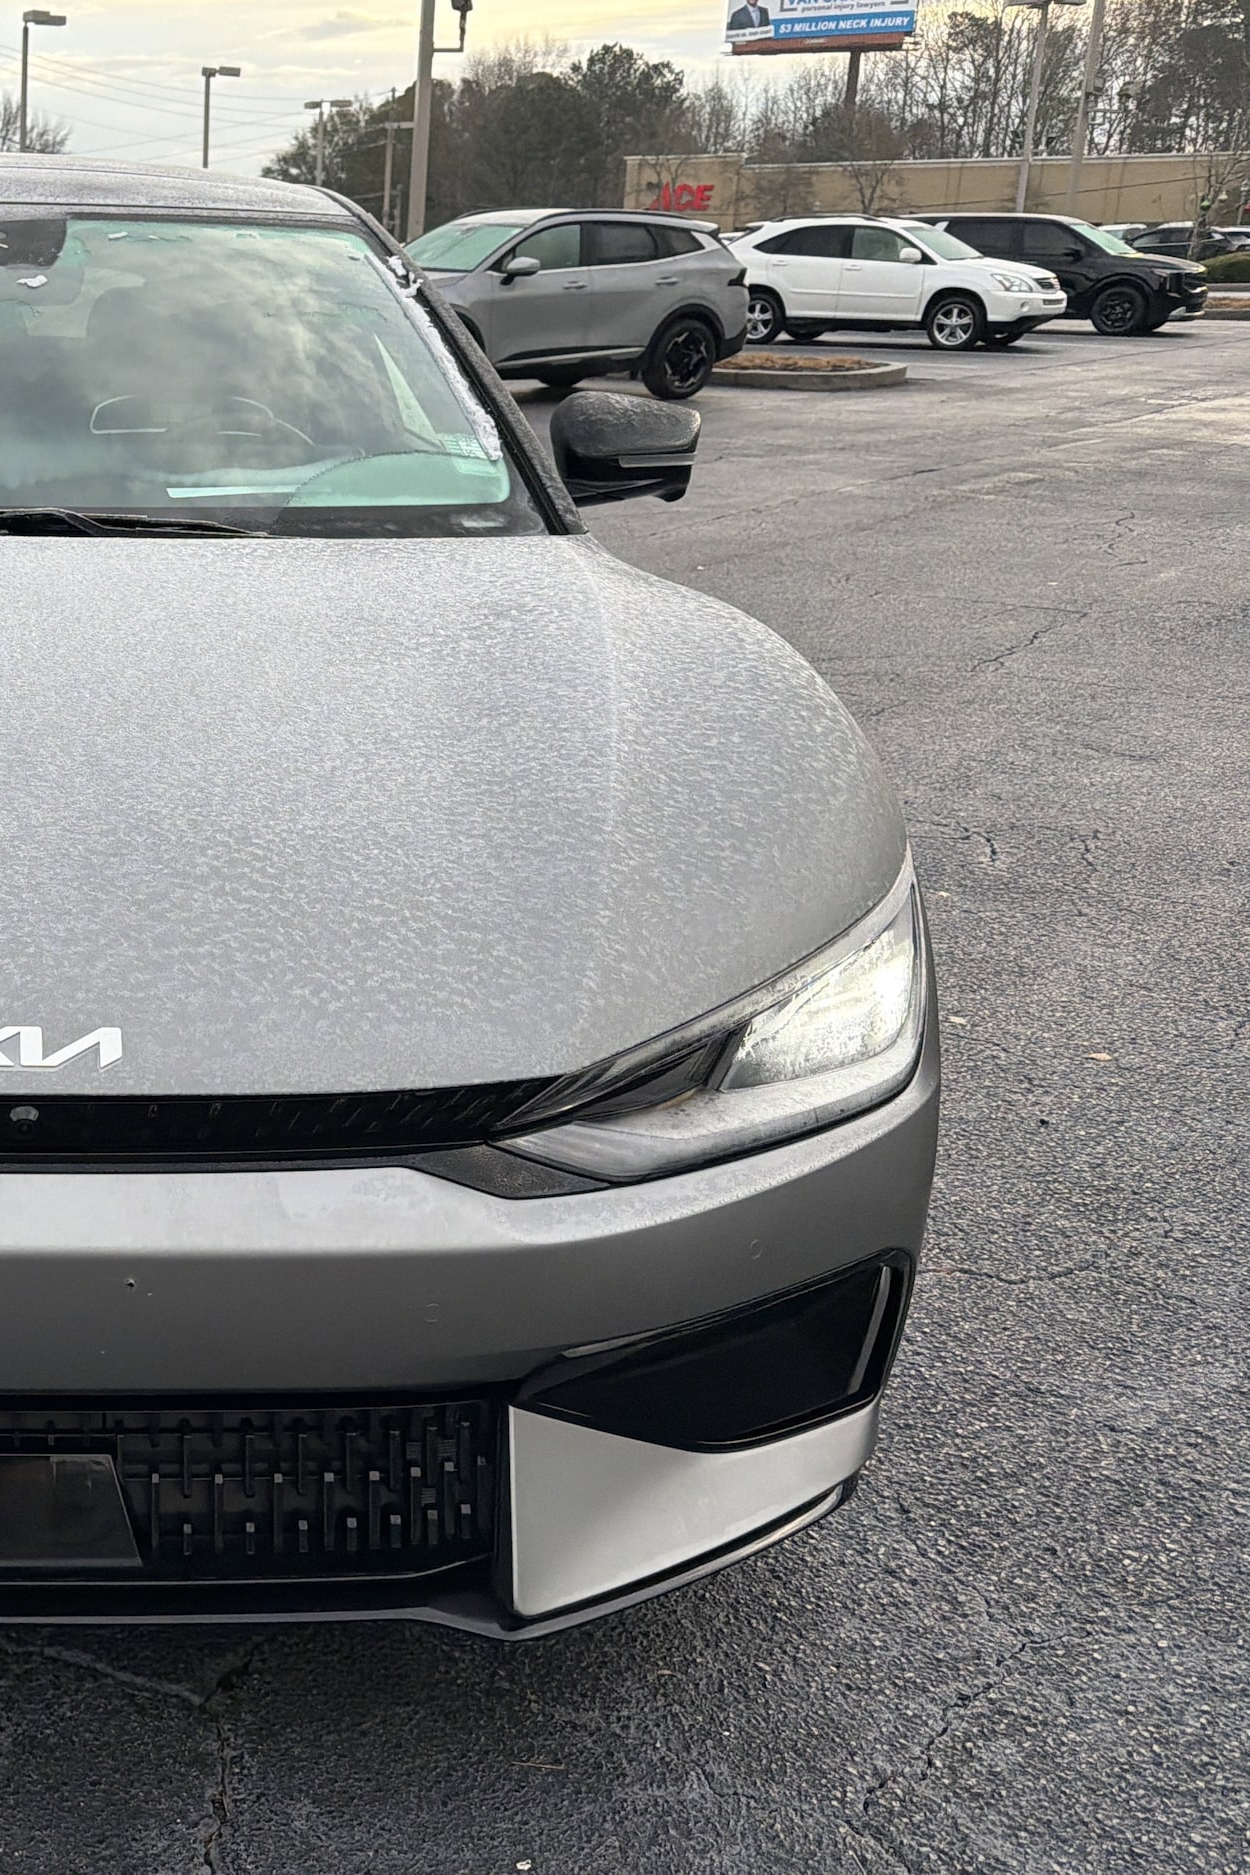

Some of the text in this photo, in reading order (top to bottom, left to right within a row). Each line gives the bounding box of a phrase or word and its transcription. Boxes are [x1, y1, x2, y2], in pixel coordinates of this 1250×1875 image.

[801, 4, 832, 13] personal
[833, 3, 854, 11] injury
[779, 16, 910, 33] $3 MILLION NECK INJURY
[649, 181, 714, 211] ACE
